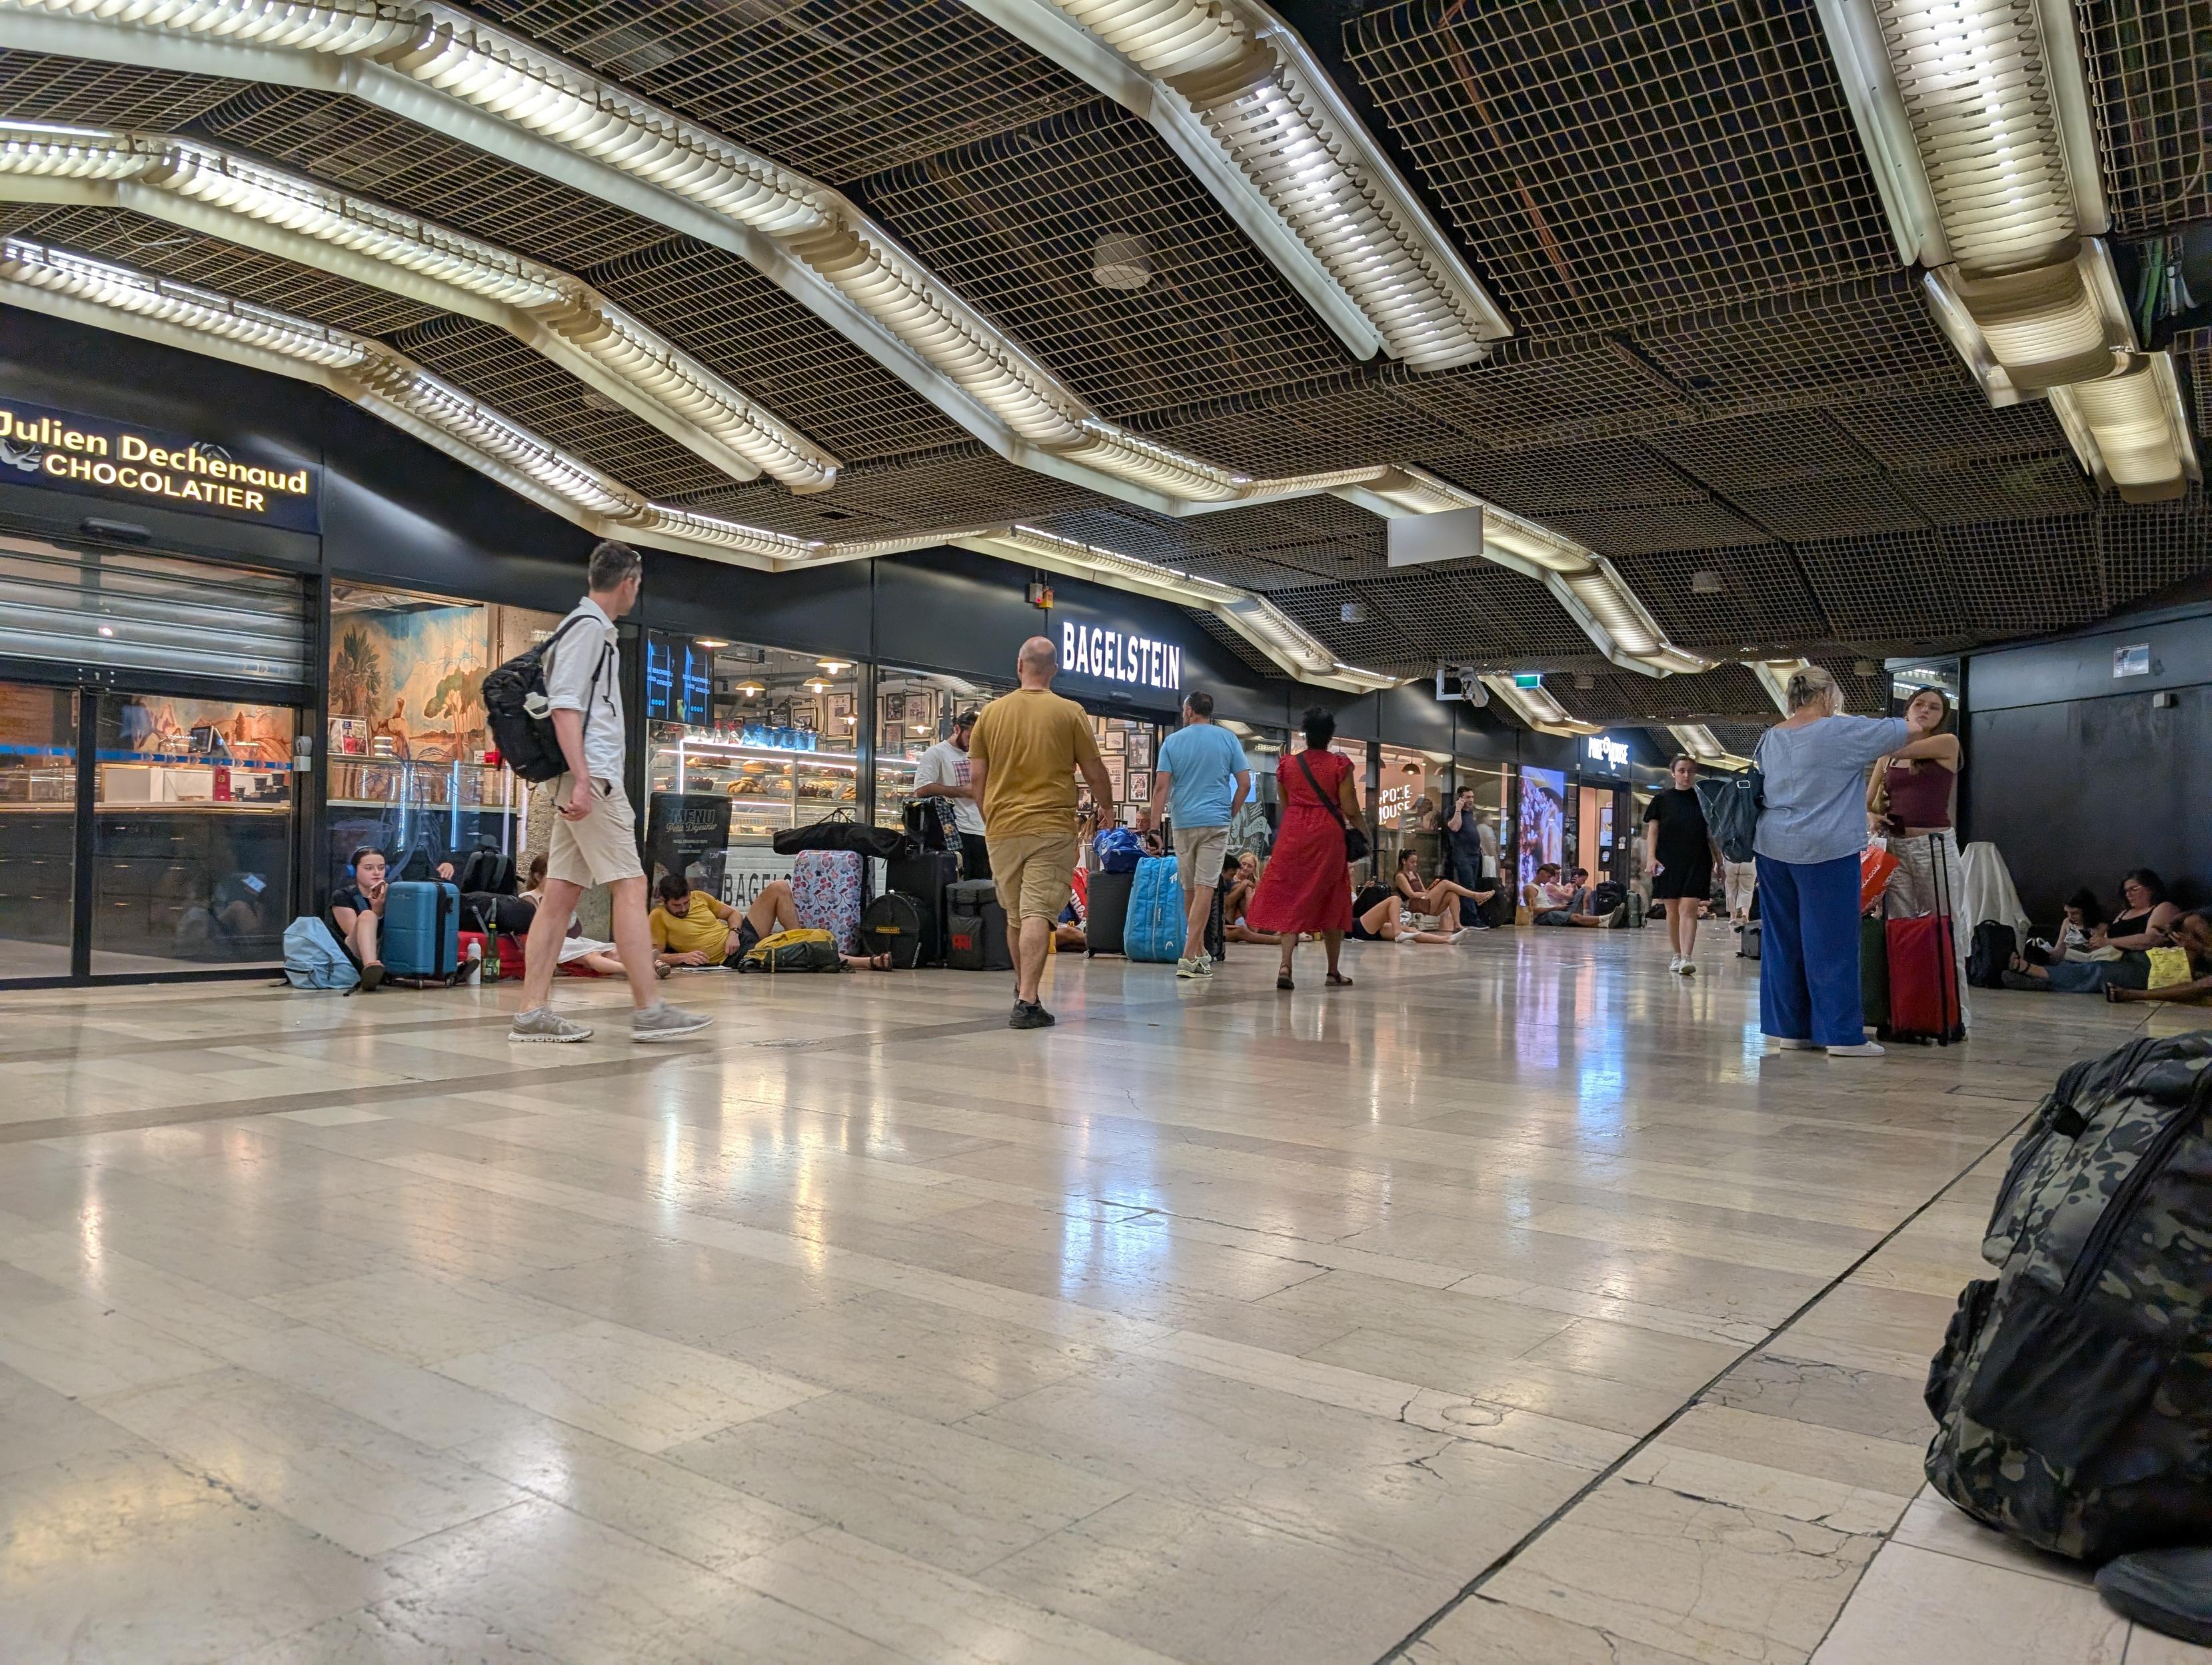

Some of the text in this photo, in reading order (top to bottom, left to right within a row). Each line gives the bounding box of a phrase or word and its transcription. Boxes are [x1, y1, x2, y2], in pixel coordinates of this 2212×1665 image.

[0, 411, 308, 494] Julien Dechenaud
[45, 454, 264, 512] CHOCOLATIER
[1062, 622, 1180, 690] BAGELSTEIN
[671, 808, 716, 825] MENU
[723, 873, 792, 907] BAG
